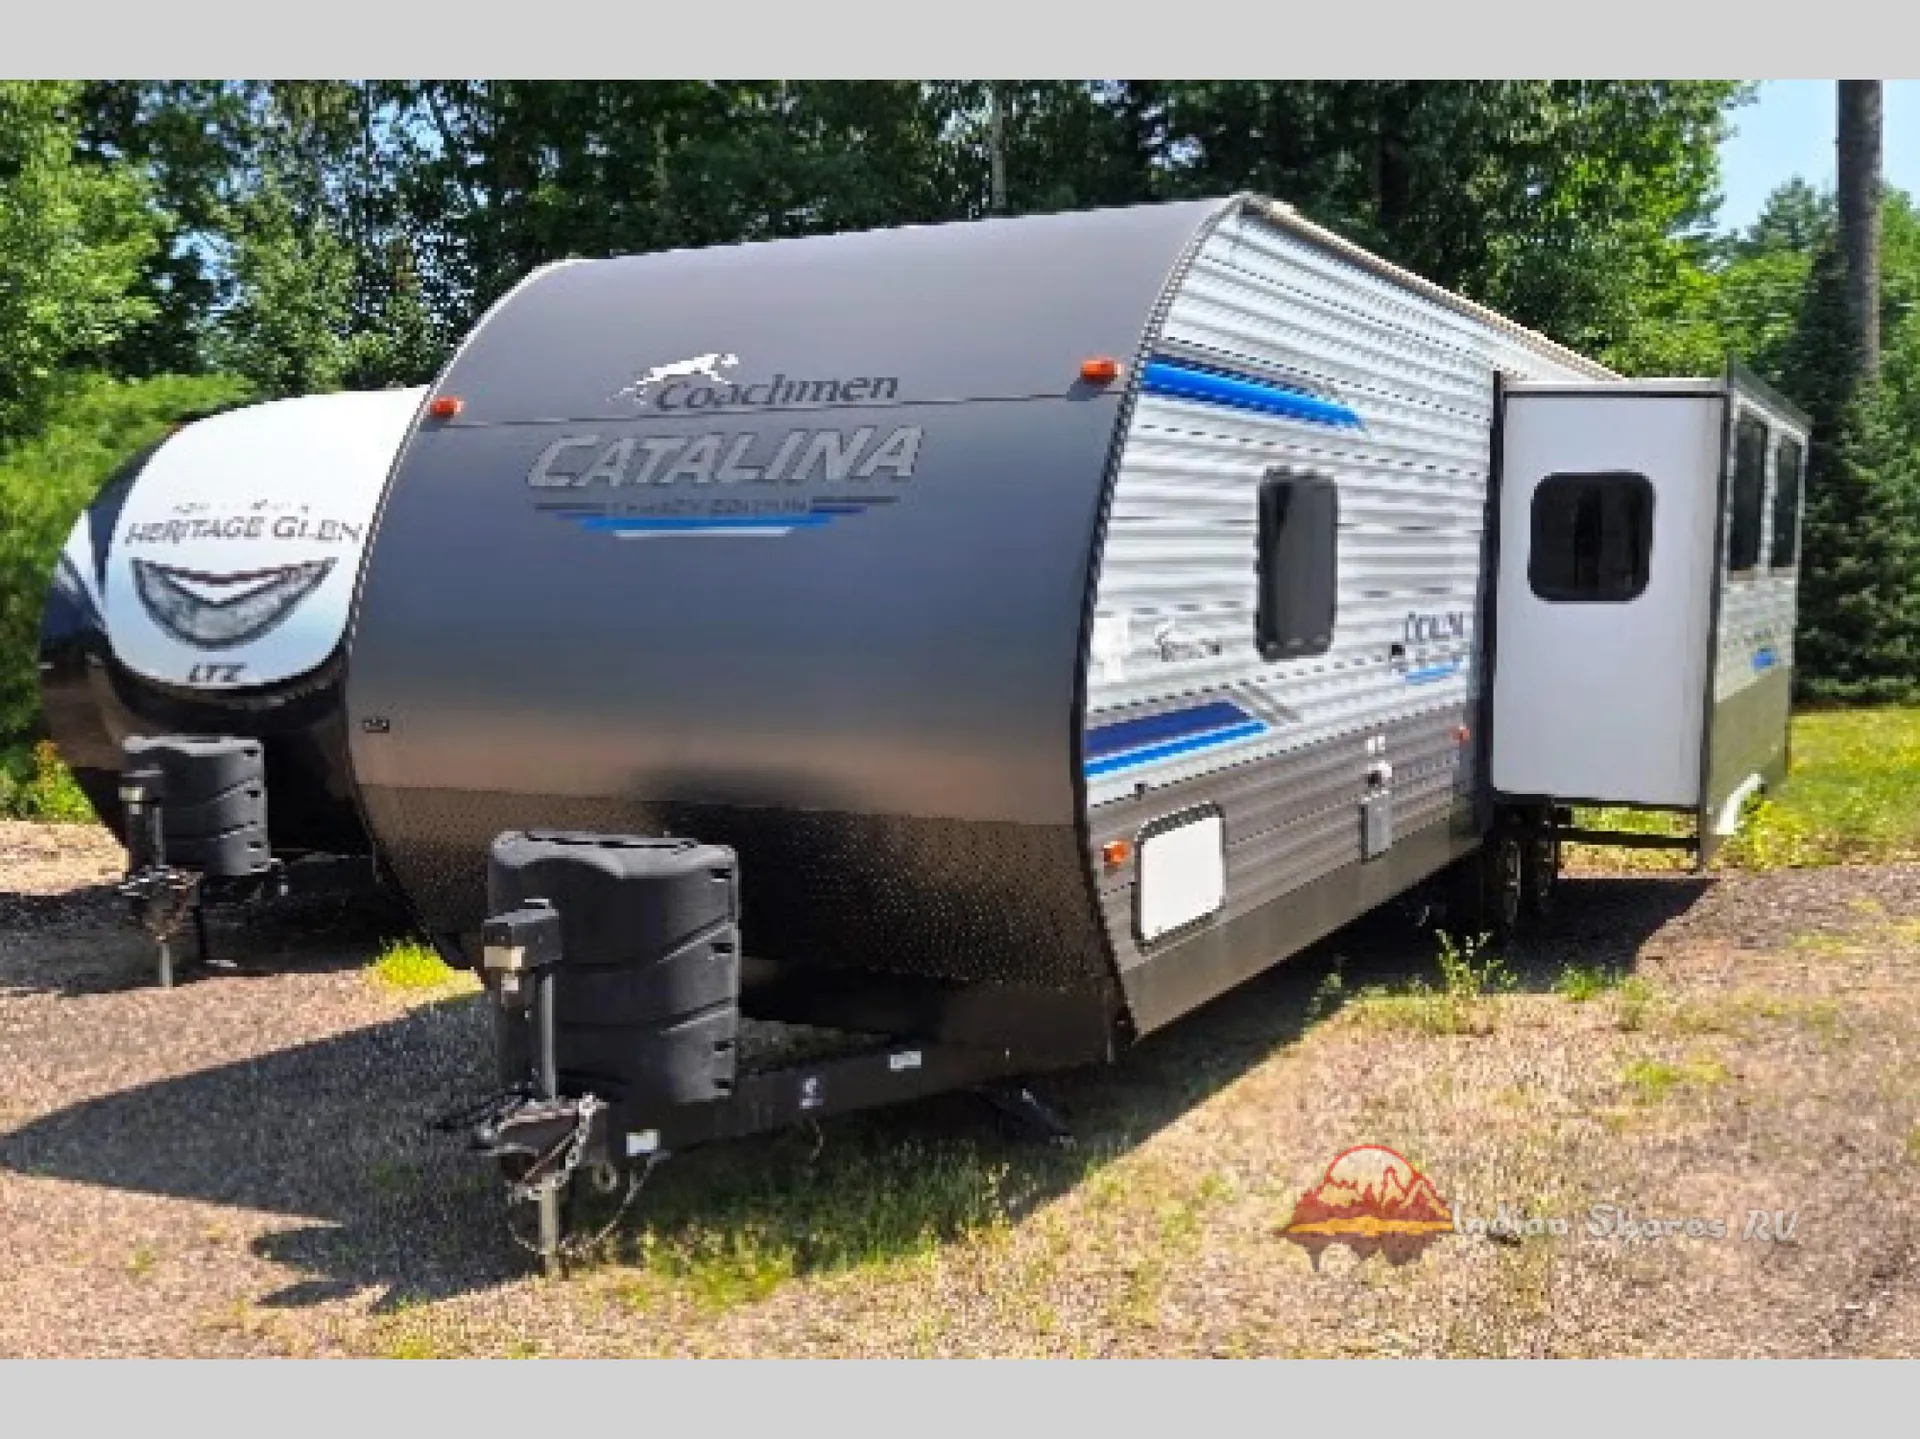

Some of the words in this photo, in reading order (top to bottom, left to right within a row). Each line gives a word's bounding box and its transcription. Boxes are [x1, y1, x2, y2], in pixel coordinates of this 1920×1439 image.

[526, 424, 925, 488] CATALINA
[127, 516, 267, 544] HERITAGE
[273, 516, 363, 542] GLEN
